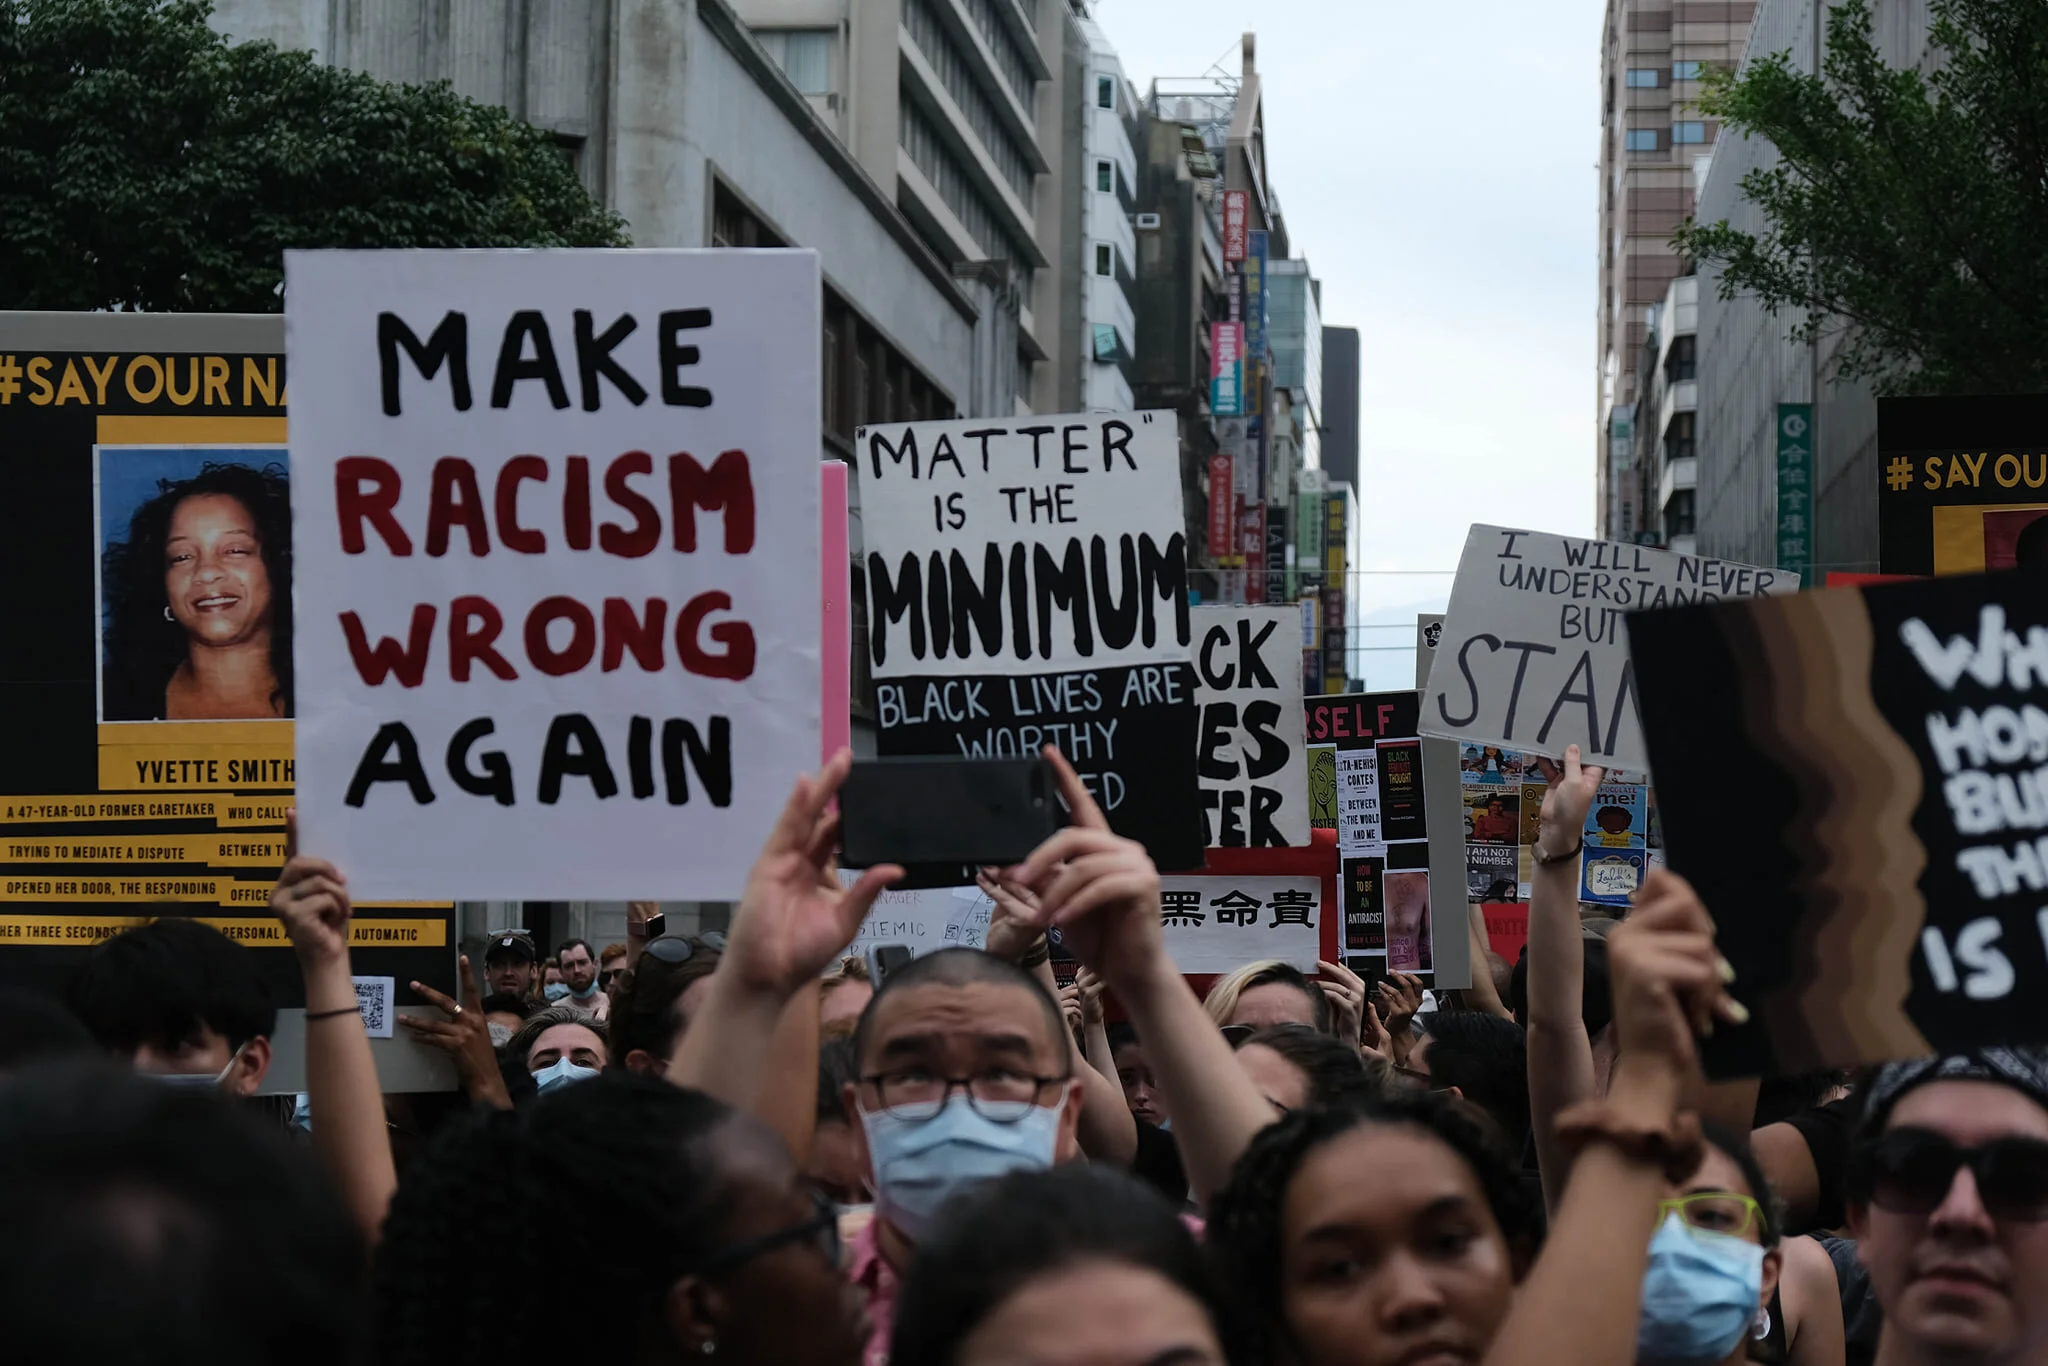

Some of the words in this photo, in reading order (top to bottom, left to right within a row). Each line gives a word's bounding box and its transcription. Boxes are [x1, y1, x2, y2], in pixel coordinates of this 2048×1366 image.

[378, 308, 713, 416] MAKE
[124, 355, 231, 406] OUR
[243, 357, 288, 407] N
[1923, 452, 1988, 491] SAY
[336, 450, 756, 558] RACISM
[935, 492, 965, 532] IS
[999, 484, 1077, 524] THE
[1497, 531, 1529, 560] I
[1563, 540, 1651, 573] WILL
[1677, 556, 1775, 598] NEVER
[868, 532, 1190, 667] MINIMUM
[1560, 604, 1622, 645] BUT
[338, 591, 756, 688] WRONG
[877, 680, 990, 728] BLACK
[1008, 672, 1103, 717] LIVES
[1121, 665, 1184, 708] ARE
[345, 714, 731, 807] AGAIN
[137, 760, 218, 783] YVETTE
[228, 760, 295, 782] SMITH
[1347, 774, 1374, 786] COATES
[1348, 798, 1377, 810] BETWEEN
[1596, 793, 1635, 805] me!
[7, 806, 14, 818] A
[18, 805, 95, 818] 47-YEAR-OLD
[100, 804, 145, 816] FORMER
[149, 803, 215, 816] CARETAKER
[228, 807, 252, 819] WHO
[1346, 815, 1358, 825] THE
[1353, 830, 1365, 840] AND
[1366, 829, 1376, 840] ME
[8, 846, 50, 858] TRYING
[54, 847, 68, 858] TO
[72, 846, 122, 859] MEDIATE
[126, 847, 133, 858] A
[137, 847, 185, 859] DISPUTE
[219, 844, 271, 857] BETWEEN
[1472, 847, 1488, 857] AM
[1490, 848, 1511, 858] NOT
[1471, 856, 1514, 867] NUMBER
[7, 882, 50, 894] OPENED
[55, 882, 77, 894] HER
[82, 882, 115, 896] DOOR,
[120, 882, 141, 894] THE
[145, 882, 216, 894] RESPONDING
[1356, 881, 1363, 893] TO
[1365, 880, 1373, 893] BE
[1348, 911, 1383, 924] ANTIRACIST
[26, 926, 61, 938] THREE
[222, 927, 280, 940] PERSONAL
[354, 929, 418, 941] AUTOMATIC
[1921, 915, 2016, 1001] IS
